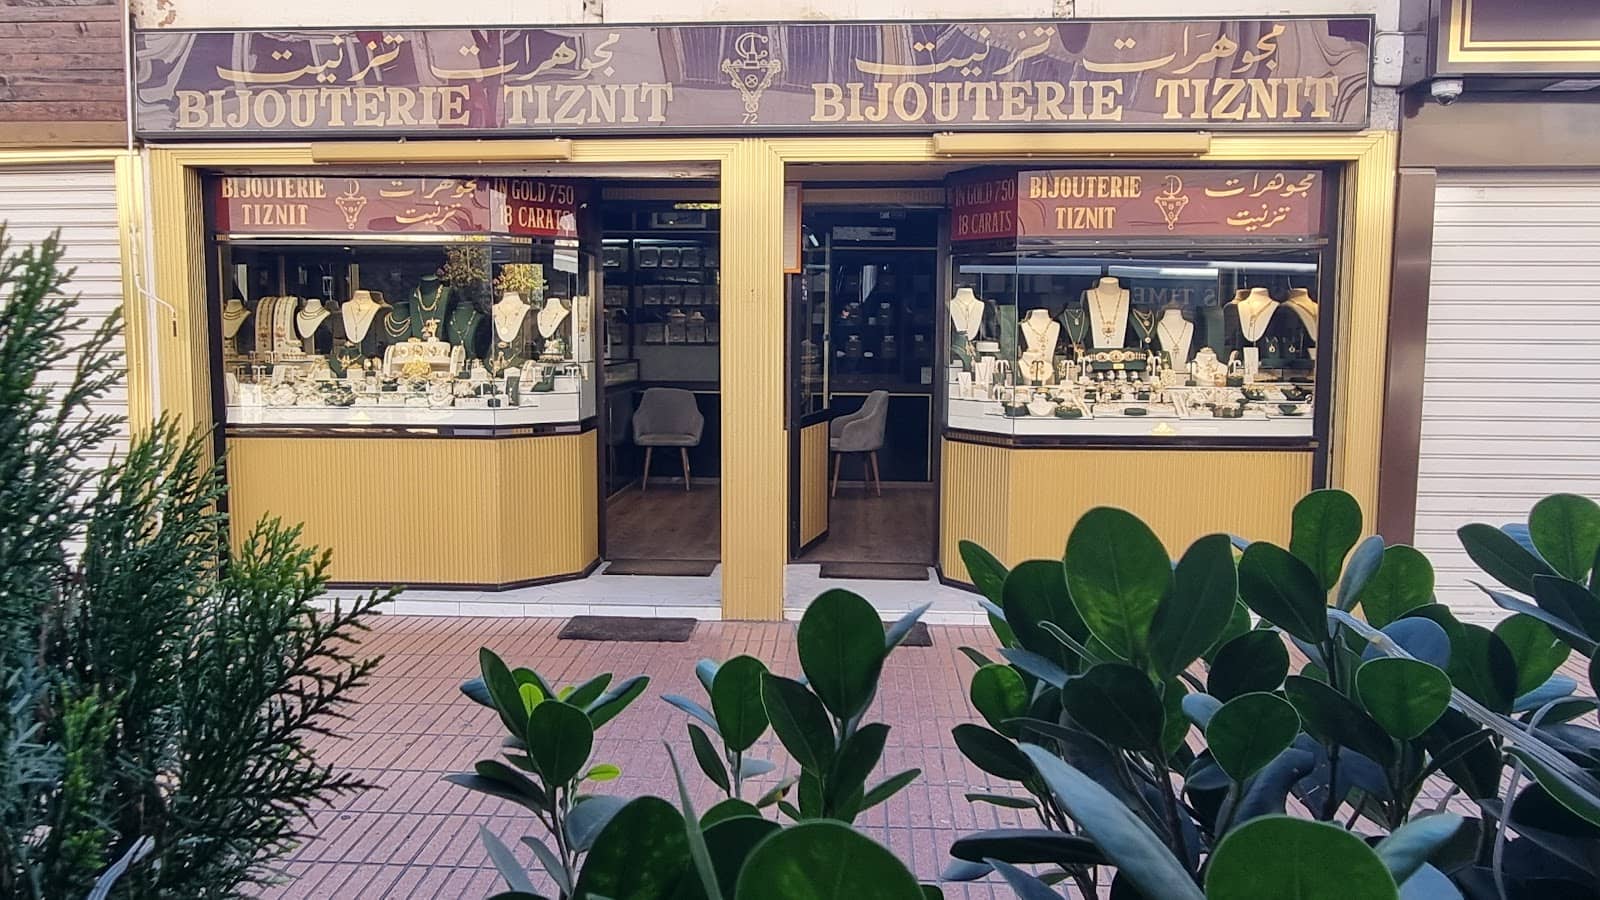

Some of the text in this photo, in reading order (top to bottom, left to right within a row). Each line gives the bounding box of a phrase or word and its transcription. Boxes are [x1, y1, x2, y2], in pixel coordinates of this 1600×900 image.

[431, 33, 620, 80] مجوهرات
[1083, 24, 1285, 74] مجوهرات
[176, 82, 672, 128] BIJOUTERIE TIZNIT
[810, 76, 1338, 121] BIJOUTERIE TIZNIT
[742, 113, 758, 124] 72
[222, 177, 326, 198] BIJOUTERIE
[512, 180, 546, 203] GOLD
[550, 183, 574, 205] 750
[967, 182, 993, 205] GOLD
[994, 179, 1015, 203] 750
[1030, 176, 1141, 198] BIJOUTERIE
[1205, 172, 1315, 198] مجوهرات
[242, 204, 308, 225] TIZNIT
[500, 205, 573, 232] 18 CARAT
[958, 210, 1012, 235] 18 CARATS
[1055, 207, 1116, 229] TIZNIT
